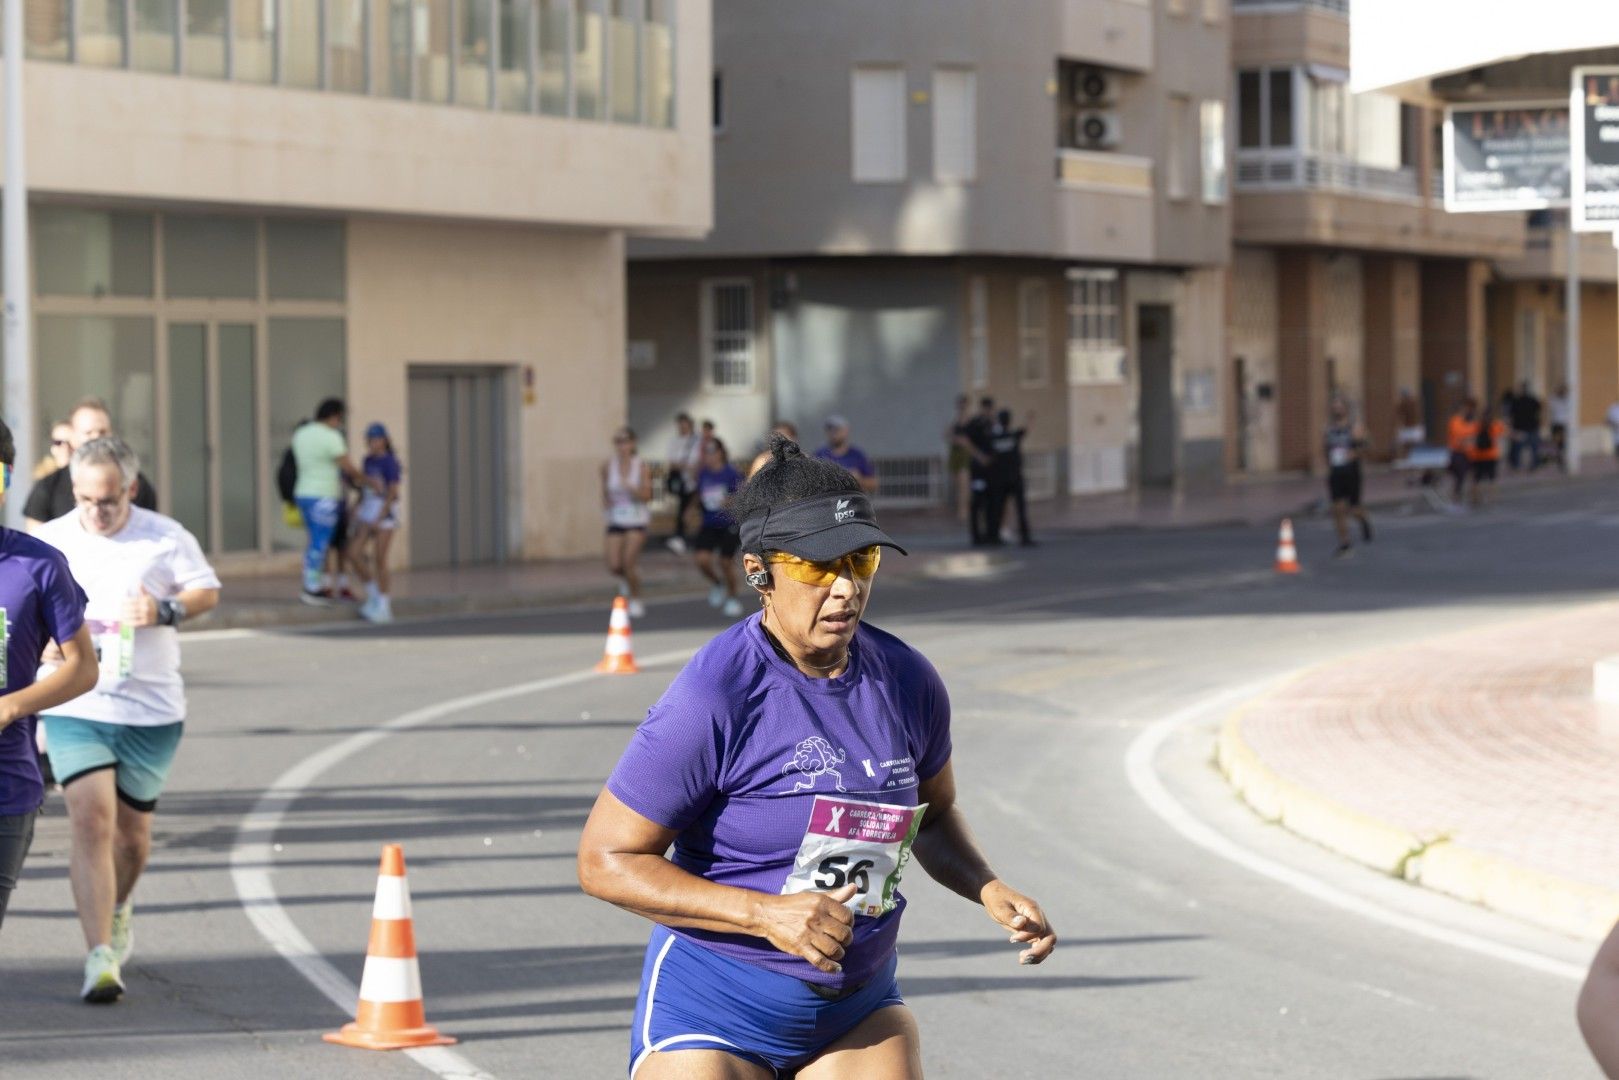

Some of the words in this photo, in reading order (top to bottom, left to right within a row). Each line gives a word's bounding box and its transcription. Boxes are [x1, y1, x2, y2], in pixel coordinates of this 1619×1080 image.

[861, 759, 876, 777] X
[825, 805, 846, 833] X
[814, 856, 875, 895] 56
